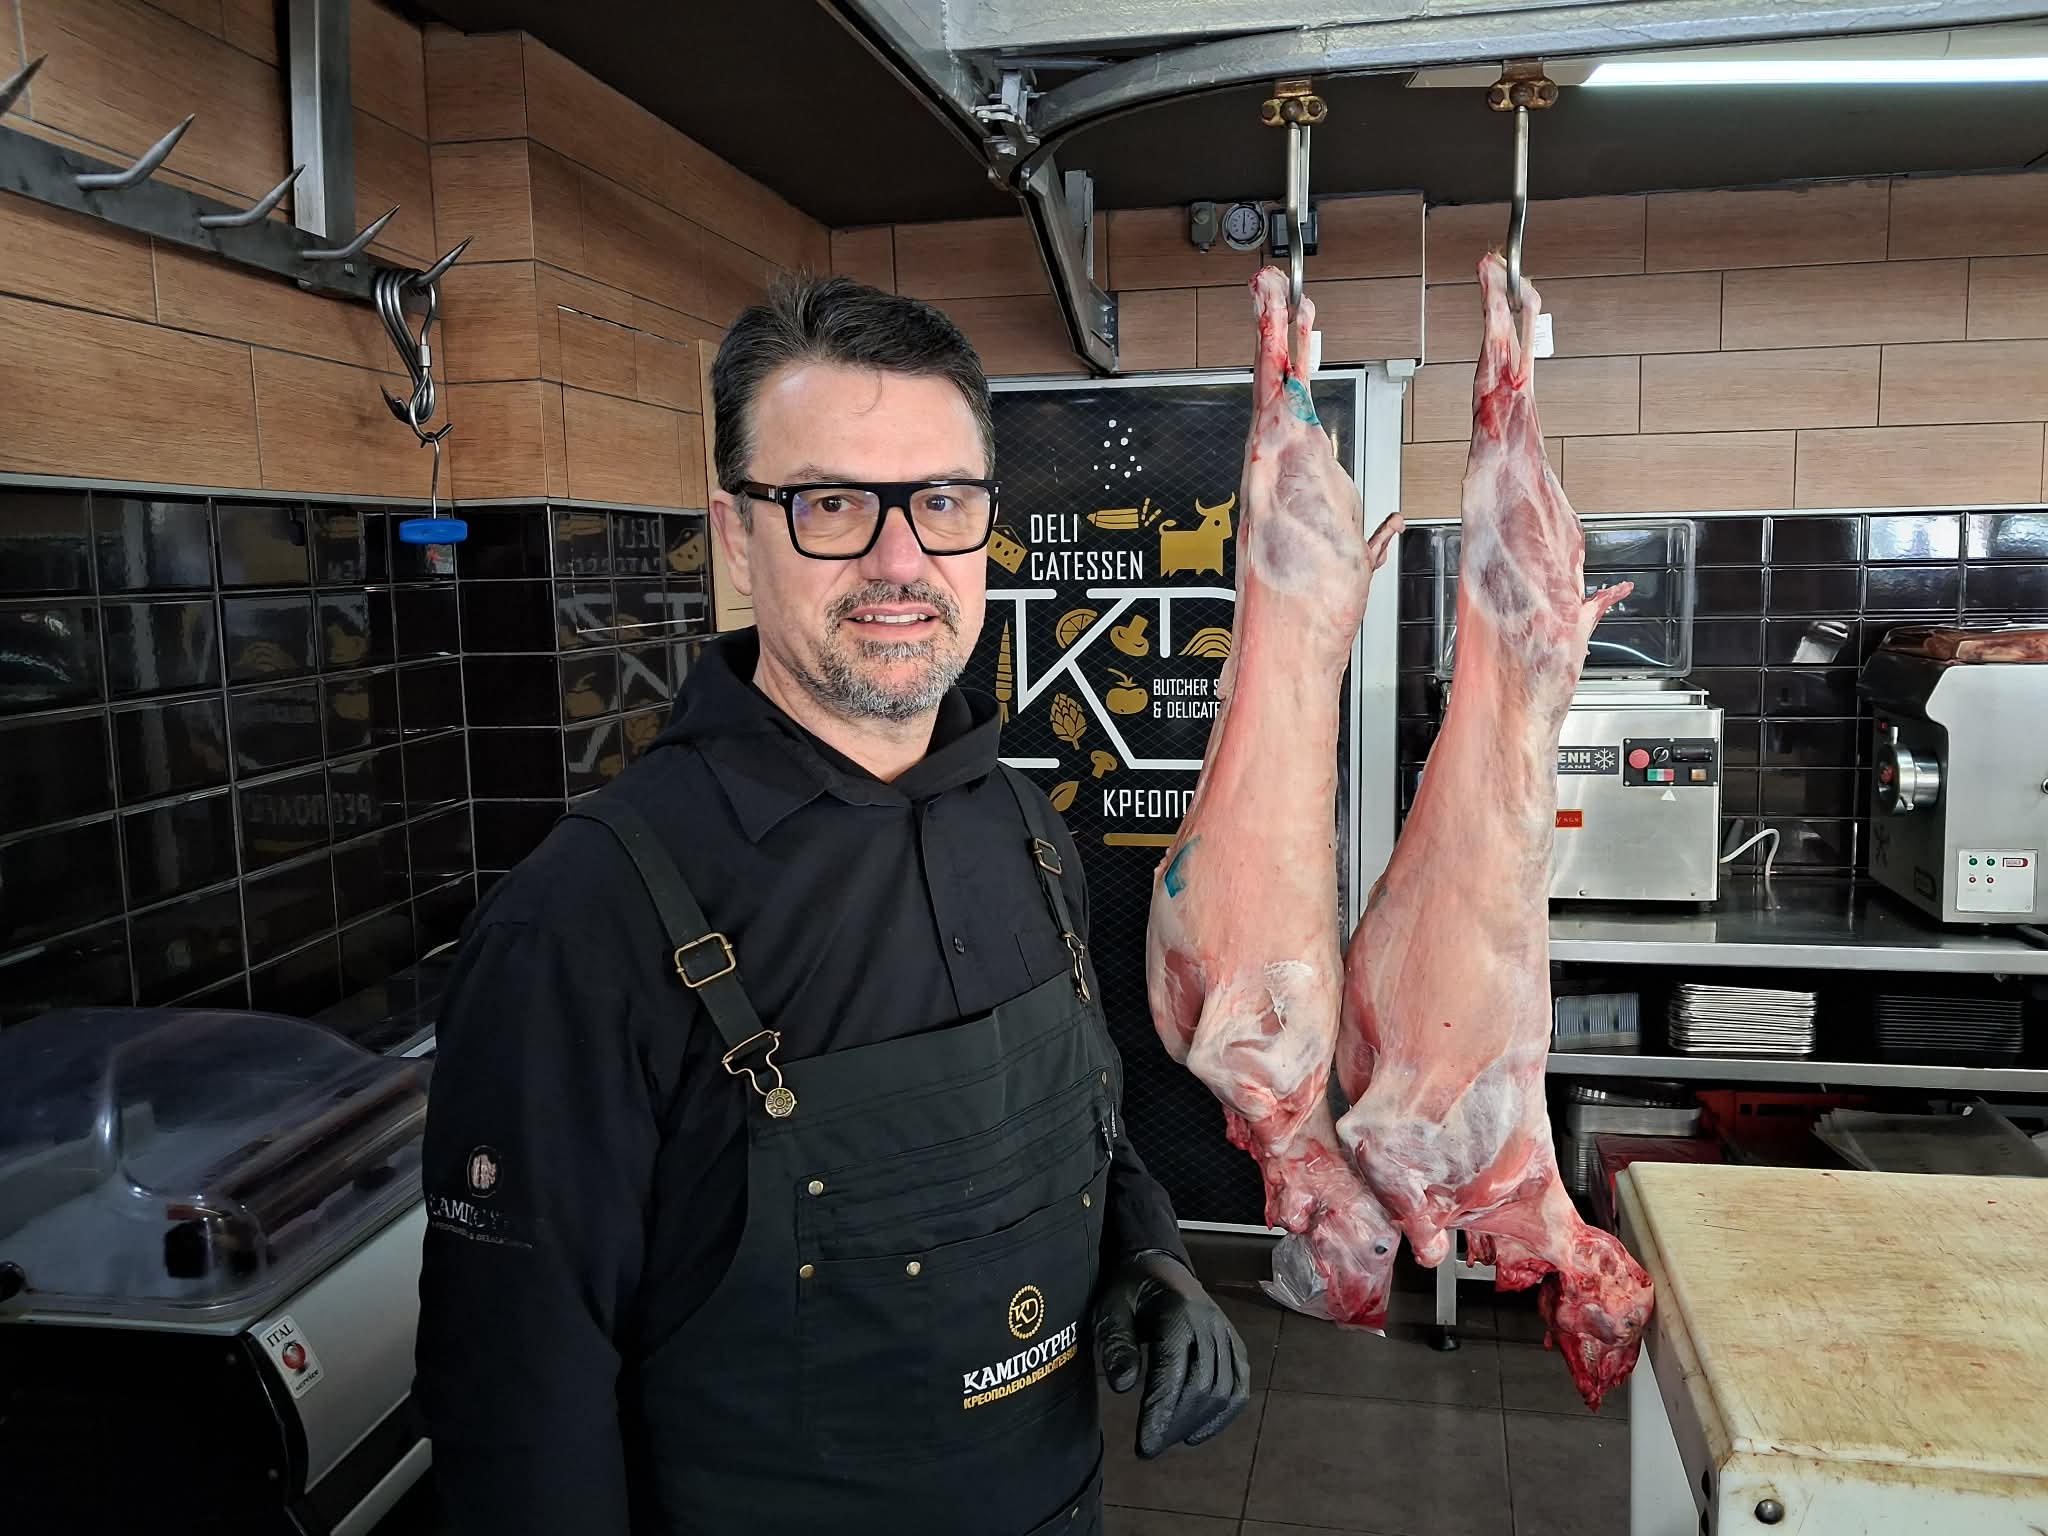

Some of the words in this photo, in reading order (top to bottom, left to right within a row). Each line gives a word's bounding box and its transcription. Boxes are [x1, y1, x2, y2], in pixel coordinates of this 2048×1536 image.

[1030, 513, 1078, 543] DELI
[1031, 550, 1143, 580] CATESSEN
[1153, 678, 1208, 696] BUTCHER
[1153, 701, 1162, 718] &
[266, 1323, 295, 1347] ITAL
